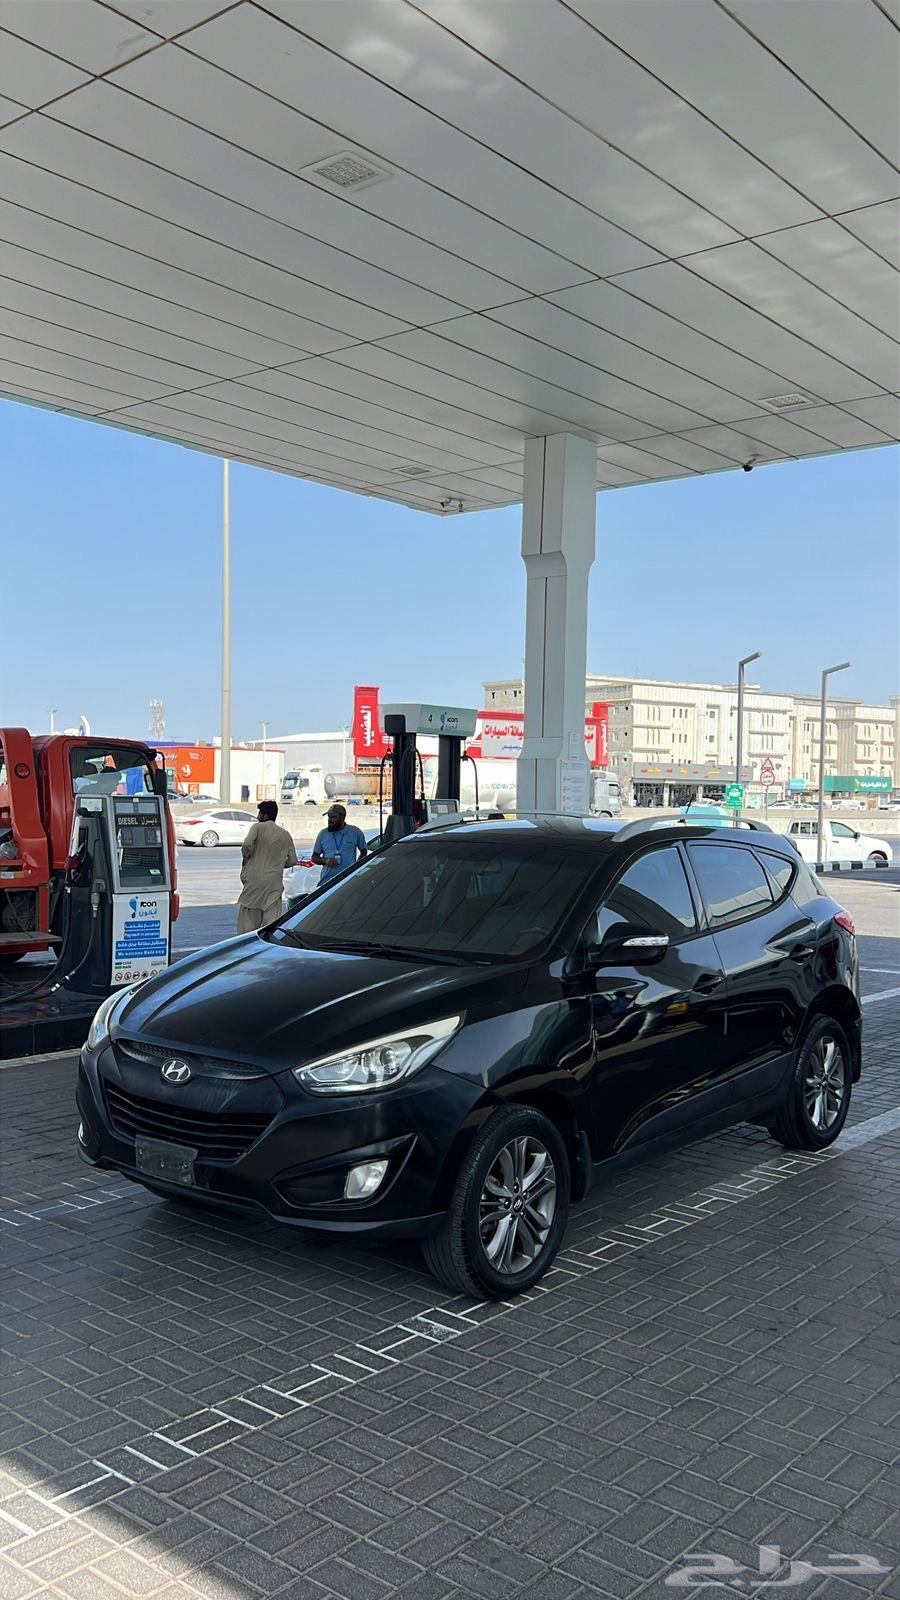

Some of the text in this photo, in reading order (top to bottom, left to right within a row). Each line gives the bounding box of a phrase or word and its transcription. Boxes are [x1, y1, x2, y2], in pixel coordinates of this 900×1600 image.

[428, 713, 433, 722] 4
[484, 725, 509, 739] السيارات
[118, 817, 139, 825] DIESEL
